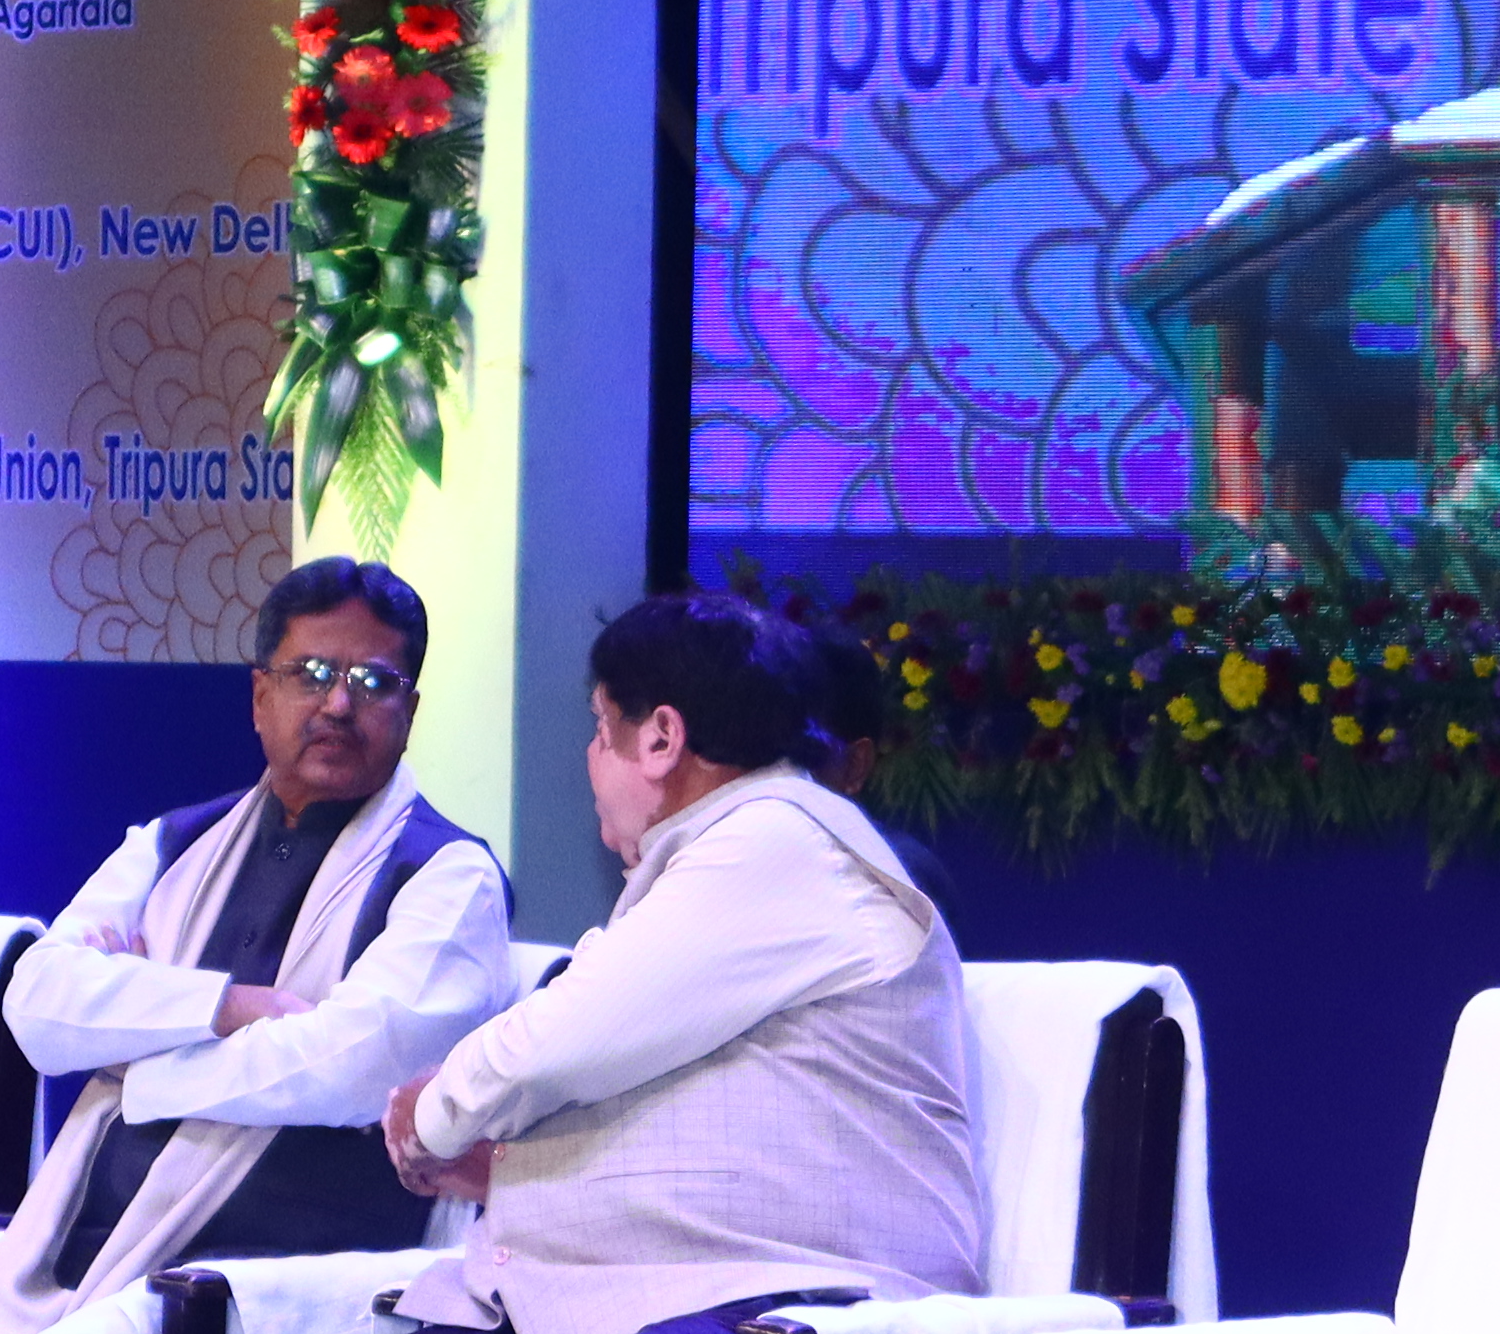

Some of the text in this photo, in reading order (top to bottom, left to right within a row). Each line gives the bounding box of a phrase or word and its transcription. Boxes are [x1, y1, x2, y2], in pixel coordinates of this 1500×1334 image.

[100, 205, 198, 257] New
[213, 200, 293, 255] Del
[103, 432, 227, 517] Tripura
[239, 432, 294, 502] Sta
